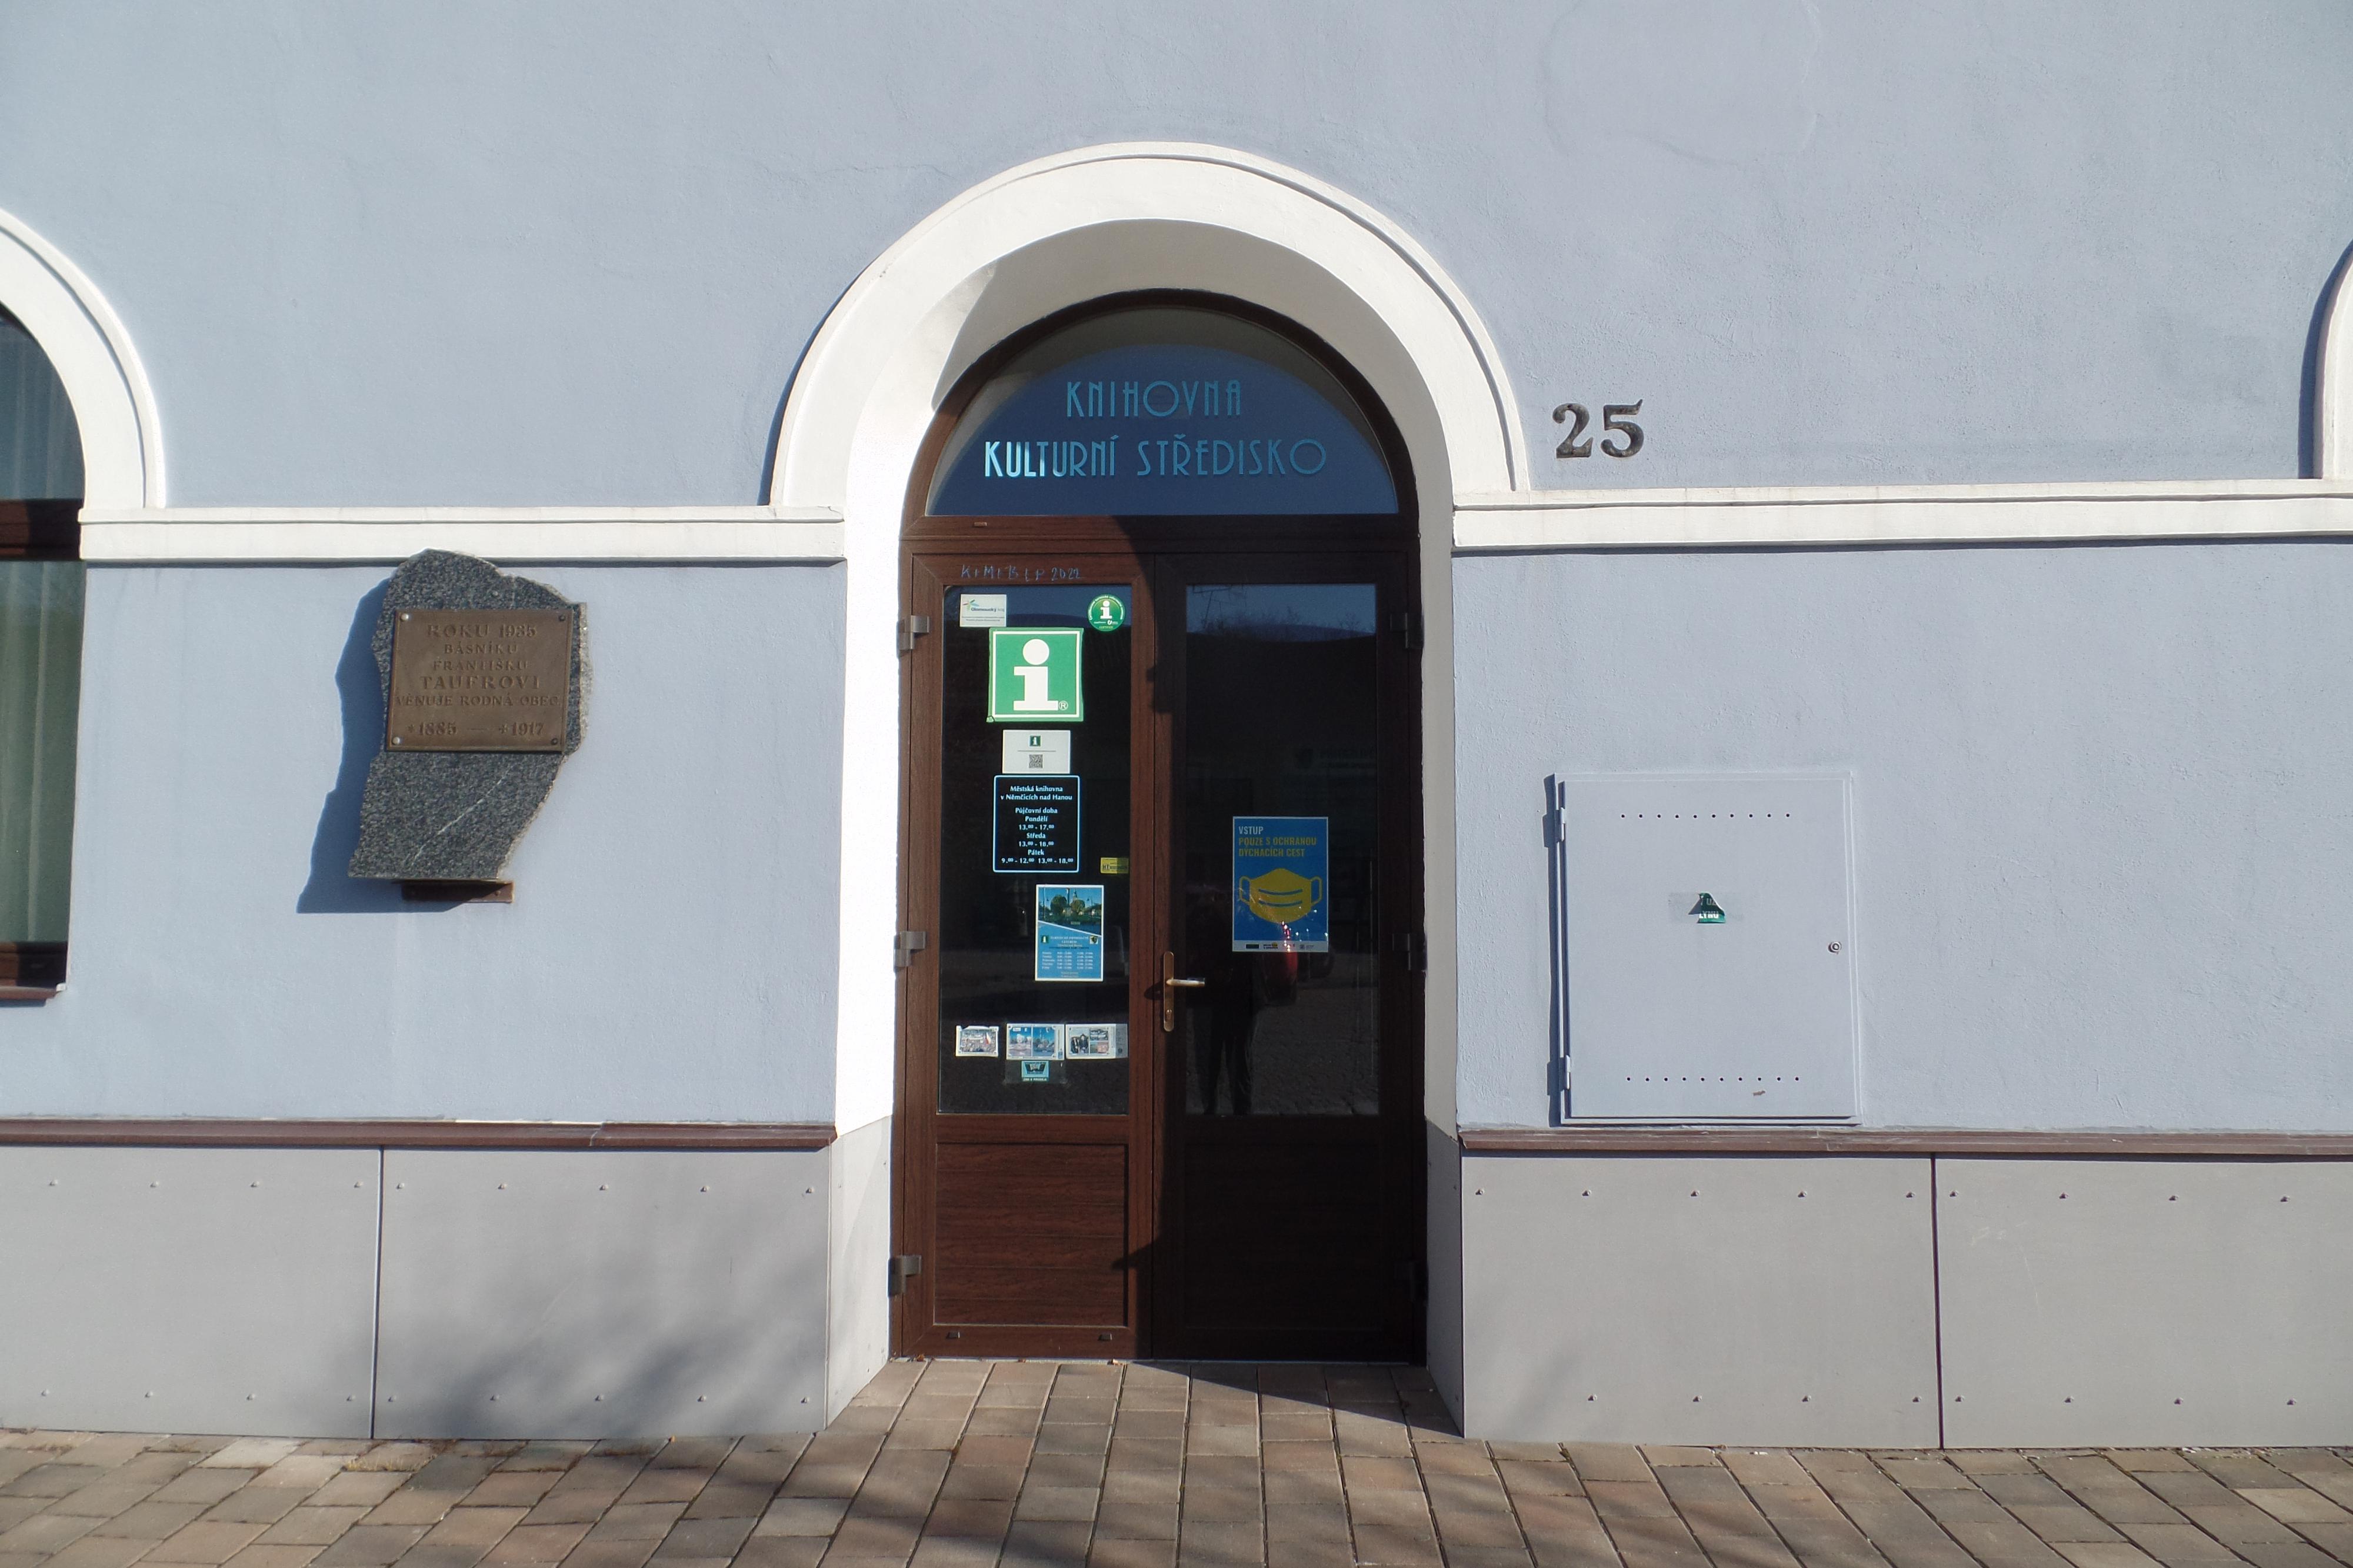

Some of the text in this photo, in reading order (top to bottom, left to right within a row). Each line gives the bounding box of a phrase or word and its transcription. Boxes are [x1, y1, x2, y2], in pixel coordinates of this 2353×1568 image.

[1066, 380, 1241, 417] KNIHOVNA
[1552, 399, 1644, 459] 25
[985, 434, 1326, 478] KULTURNÍ STŘEDISKO
[427, 624, 489, 638] ROKU
[444, 640, 518, 655] BÁSNÍKU
[433, 657, 528, 671] FRANTIŠKU
[461, 692, 513, 706] RODNÁ
[1238, 826, 1264, 835] VSTUP
[1238, 837, 1317, 846] POUZE S OCHRANOU
[1238, 846, 1305, 857] DÝCHACÍCH CEST
